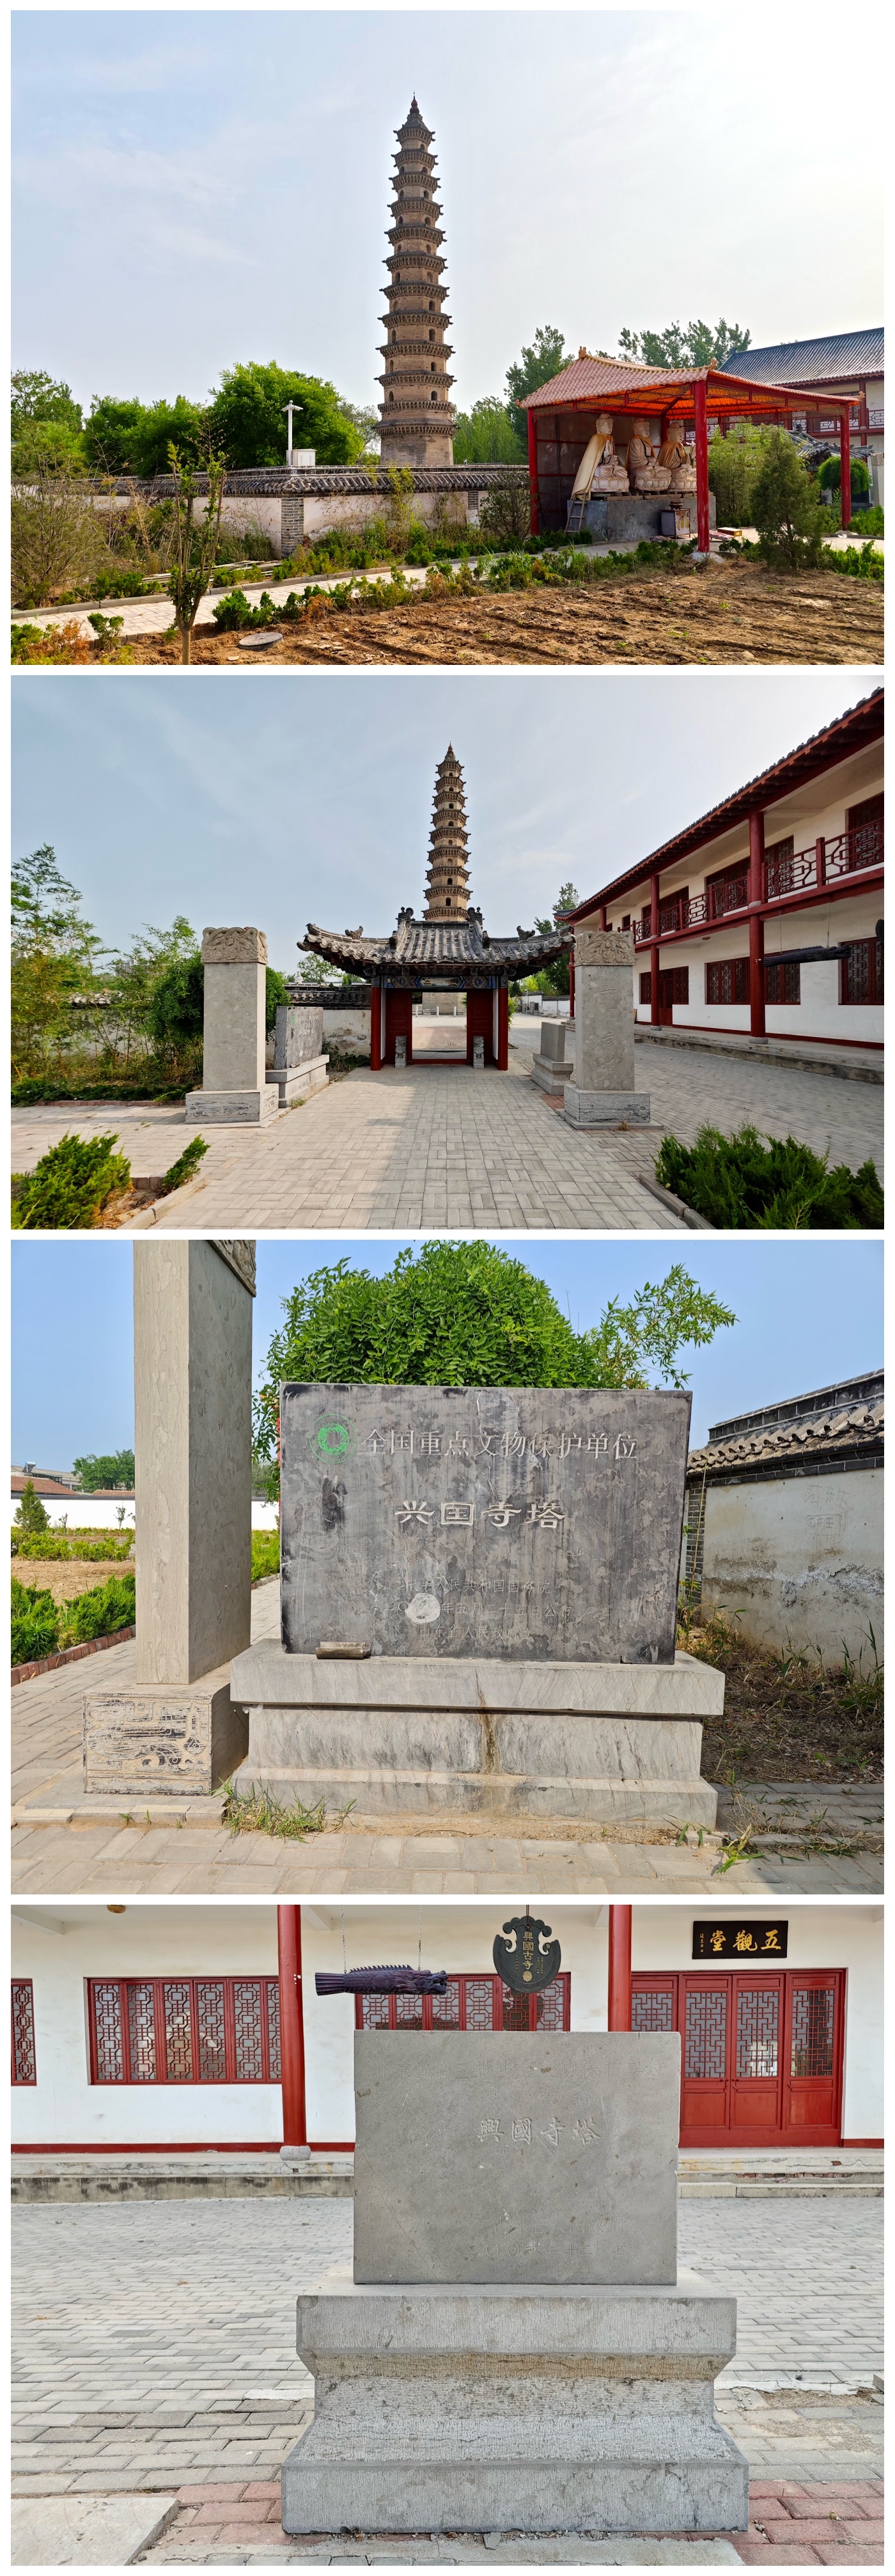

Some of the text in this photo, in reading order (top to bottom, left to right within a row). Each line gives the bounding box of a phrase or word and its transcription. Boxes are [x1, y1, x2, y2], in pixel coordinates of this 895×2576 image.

[362, 1428, 639, 1460] 全国重点文物保护单位
[394, 1499, 566, 1529] 兴国寺塔
[407, 1577, 550, 1594] 中华人民共和国国务院
[419, 1624, 533, 1640] 山东省人民政府立
[522, 1931, 534, 1970] 興國古寺
[710, 1928, 782, 1952] 五觀堂
[476, 2116, 602, 2147] 興國寺塔
